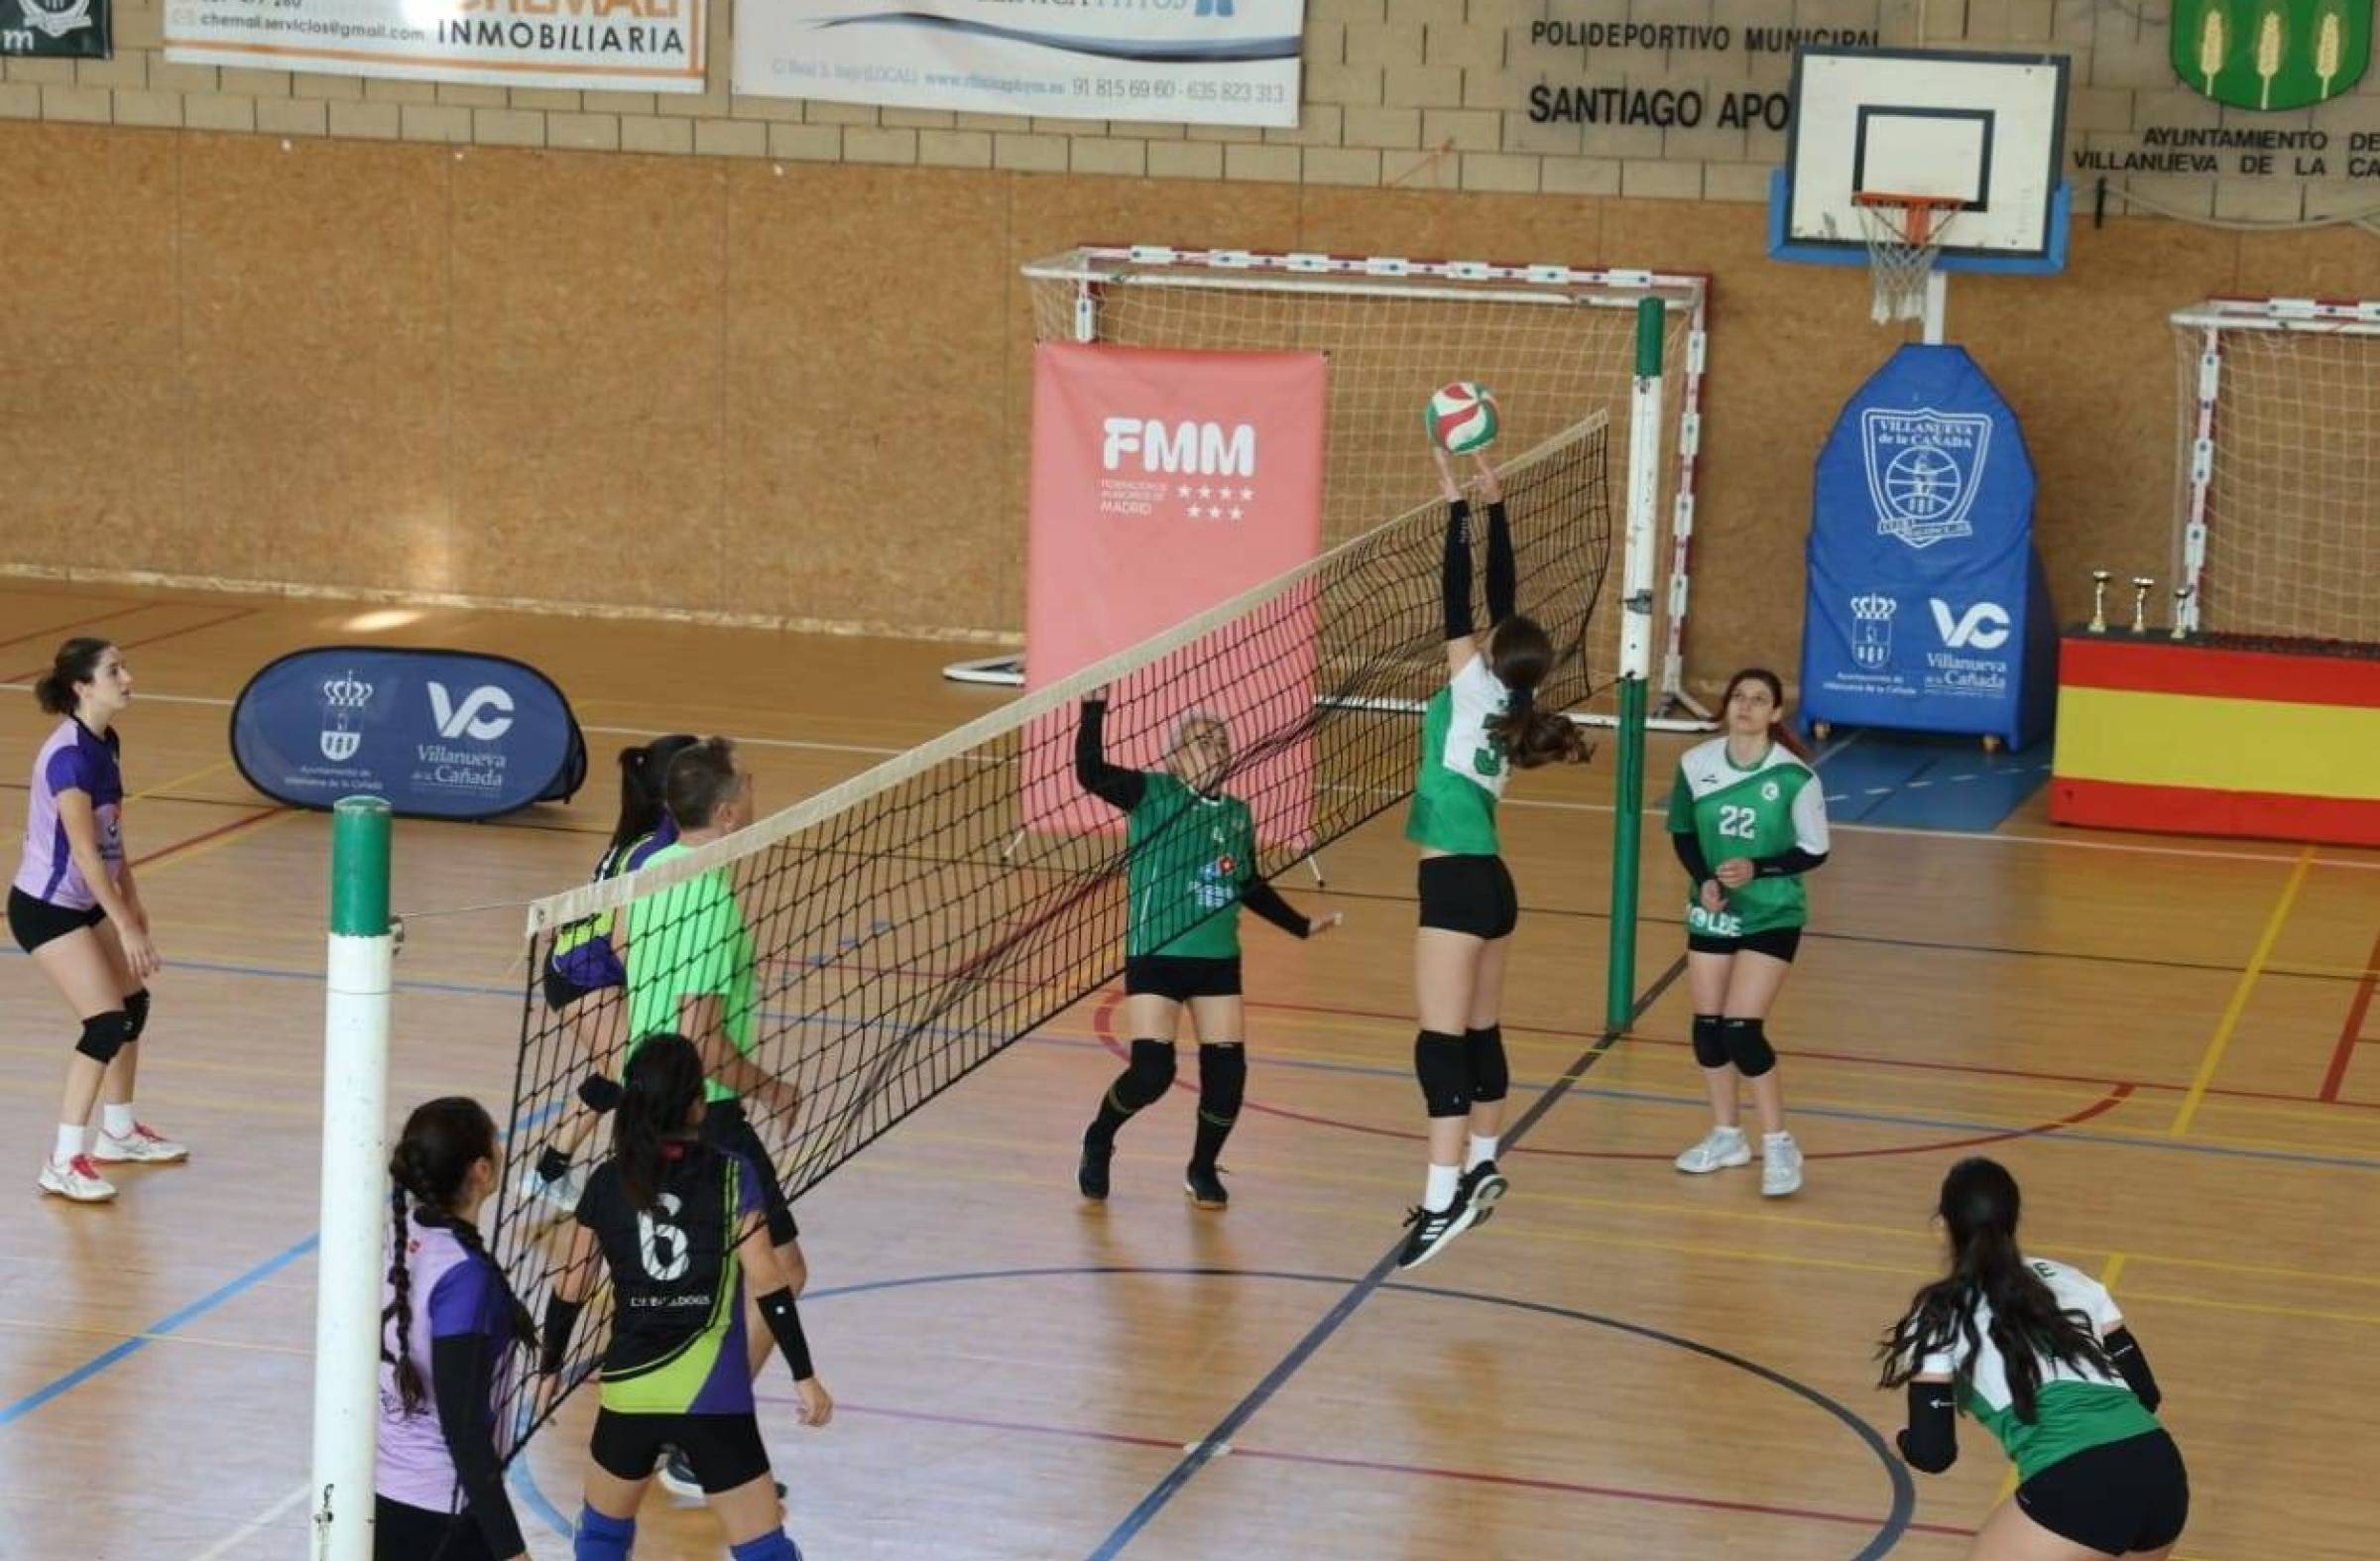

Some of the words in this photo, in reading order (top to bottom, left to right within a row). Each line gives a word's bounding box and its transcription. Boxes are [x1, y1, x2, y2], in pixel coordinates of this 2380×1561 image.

[437, 19, 683, 54] INMOBILIARIA
[1531, 21, 1730, 50] POLIDEPORTIVO
[1528, 84, 1702, 128] SANTIAGO
[2142, 127, 2328, 150] AYUNTAMIENTO
[2074, 150, 2219, 173] VILLANUEVA
[2239, 155, 2274, 175] DE
[2294, 157, 2326, 177] LA
[1103, 417, 1255, 477] FMM
[1929, 597, 2011, 650] VC
[1927, 652, 2007, 672] Villanueva
[426, 681, 515, 740] VC
[416, 744, 507, 769] Villanueva
[434, 765, 503, 786] Cañada
[1718, 804, 1756, 840] 22
[636, 1191, 691, 1281] 6
